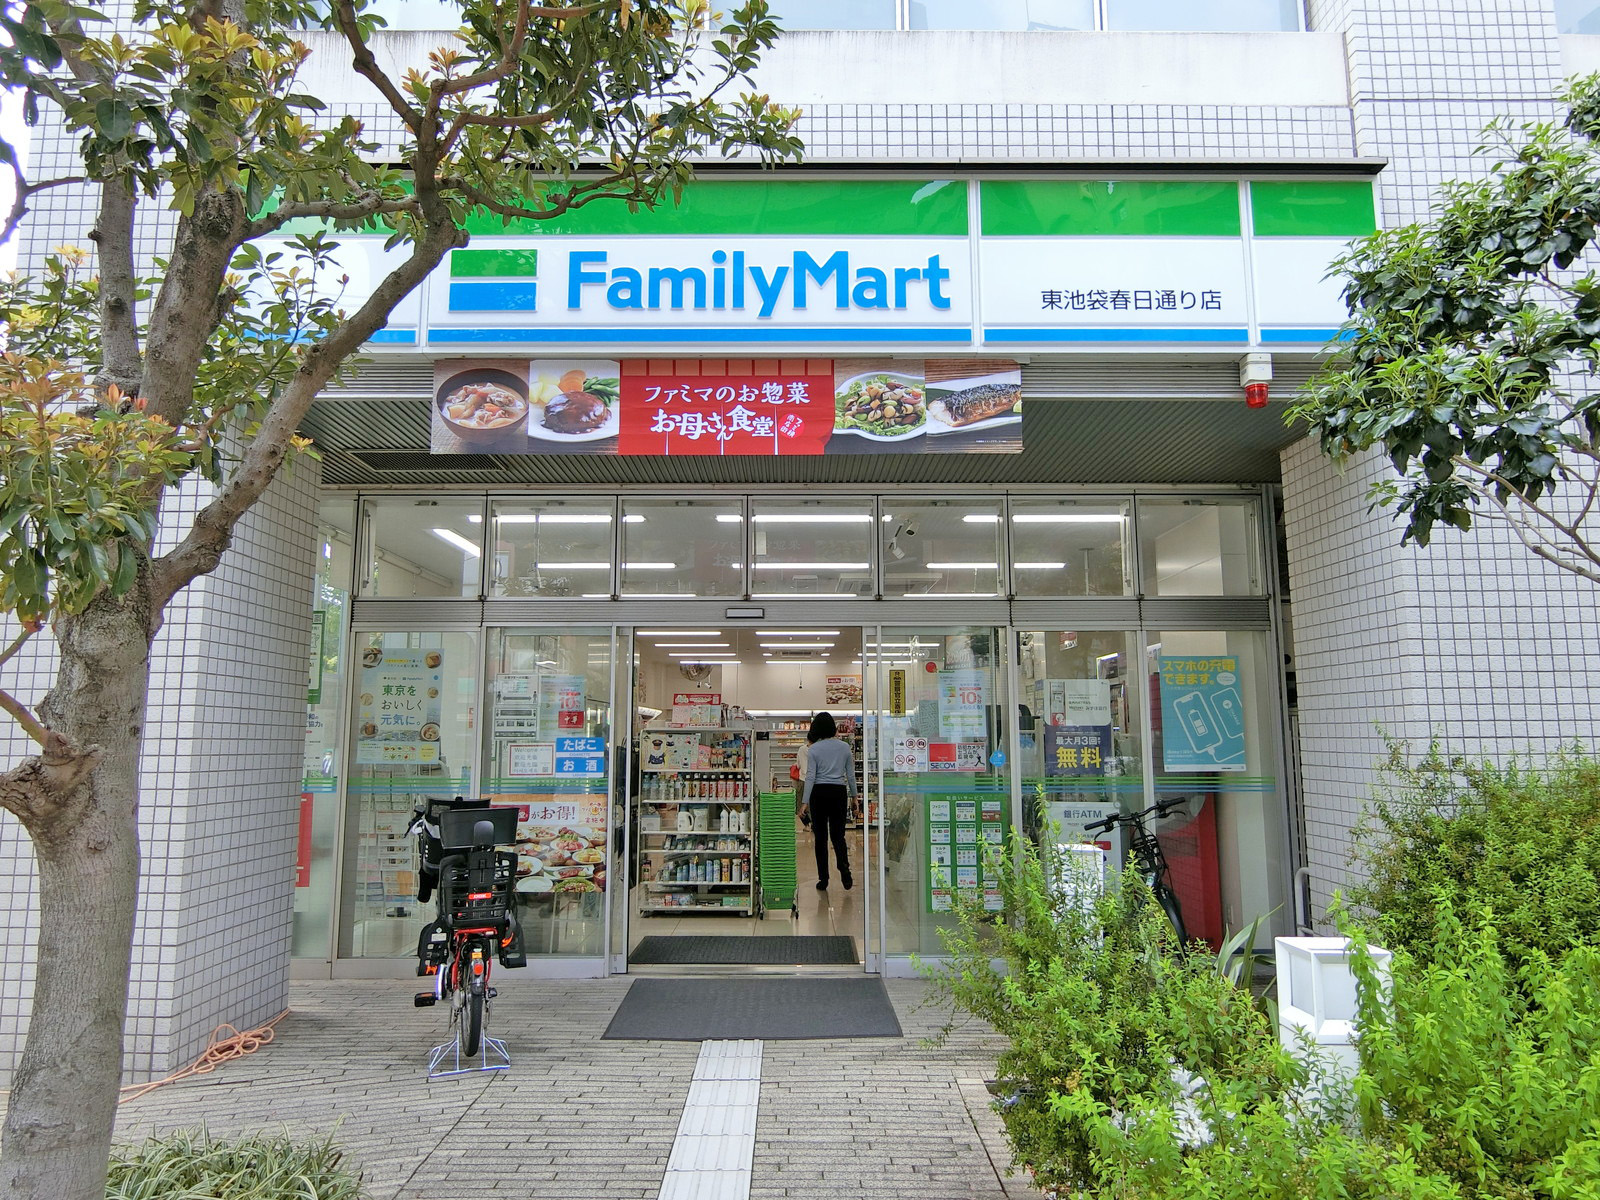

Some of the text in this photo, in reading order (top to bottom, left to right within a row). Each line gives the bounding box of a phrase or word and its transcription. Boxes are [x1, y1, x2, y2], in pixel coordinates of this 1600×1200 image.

[568, 250, 951, 319] FamilyMart
[1041, 289, 1222, 310] 東池袋春日通り店
[645, 382, 810, 404] ファミマのお惣菜
[650, 404, 774, 441] お母さん食堂
[1162, 658, 1236, 673] スマホの充電
[1162, 672, 1216, 686] できます。
[382, 684, 417, 696] 東京を
[381, 699, 423, 711] おいしく
[380, 713, 422, 726] 元気に。
[563, 739, 597, 751] たばこ
[1056, 746, 1102, 768] 無料
[531, 806, 575, 820] がお得!
[1063, 809, 1102, 819] 銀行ATM
